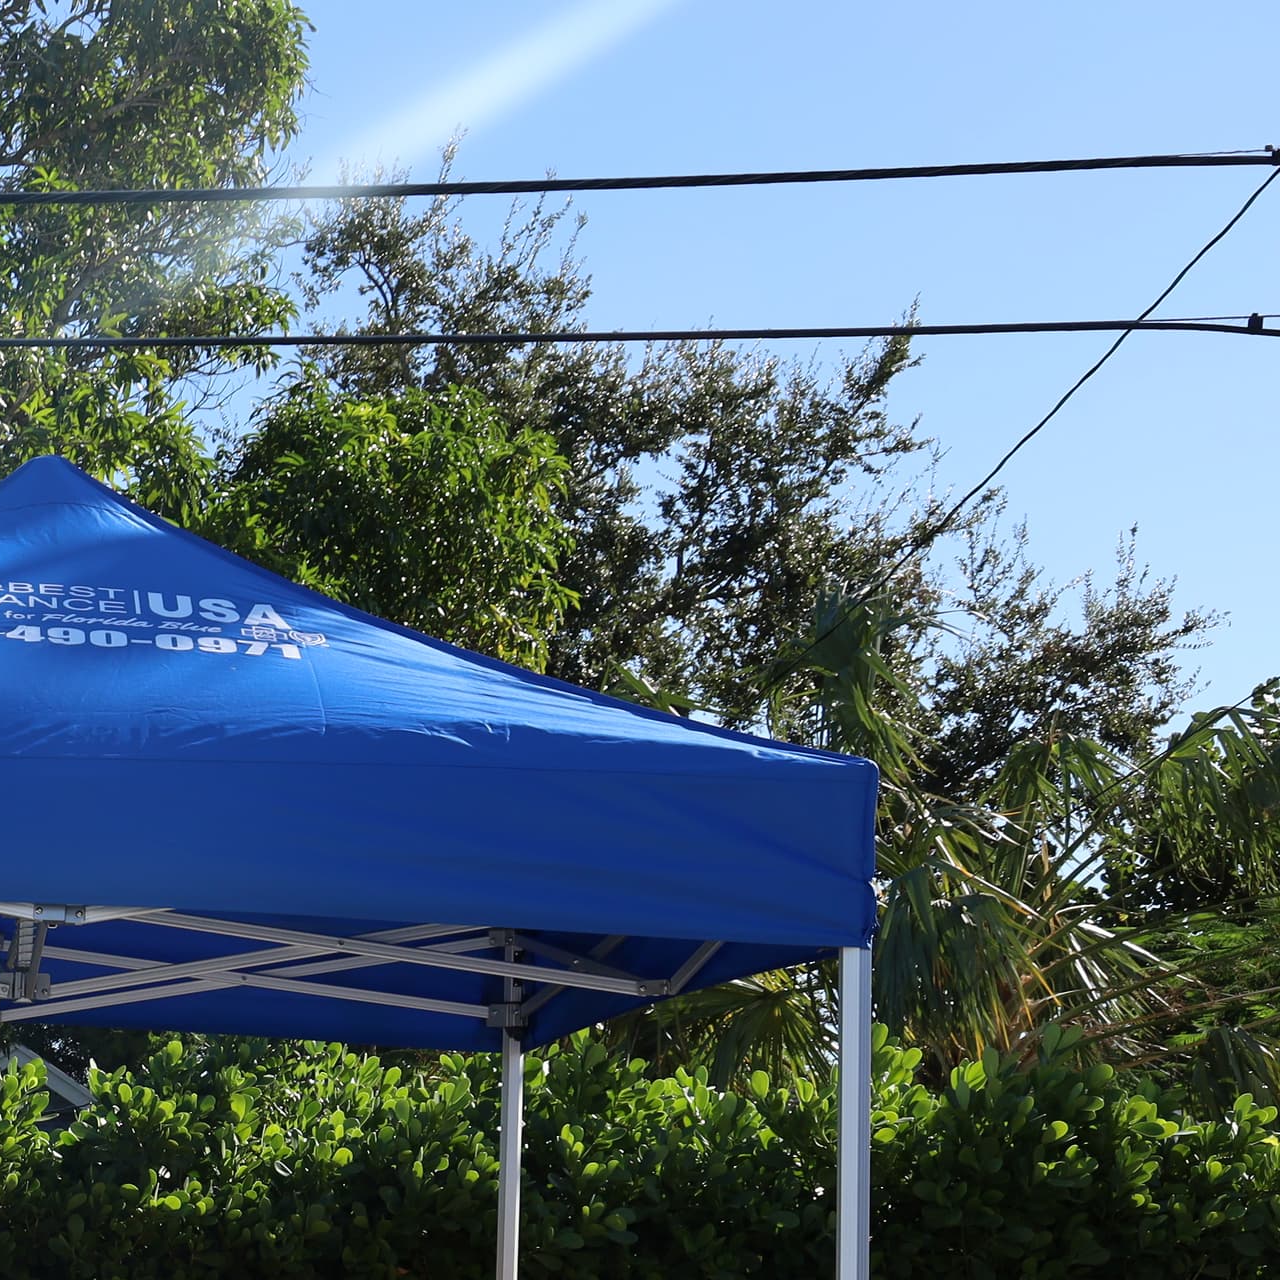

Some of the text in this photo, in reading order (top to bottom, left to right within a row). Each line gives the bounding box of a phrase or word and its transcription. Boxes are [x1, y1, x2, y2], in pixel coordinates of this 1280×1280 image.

[8, 582, 125, 599] BEST
[4, 610, 36, 620] for
[41, 613, 153, 628] Florida
[157, 620, 223, 633] Blue
[147, 591, 292, 630] USA
